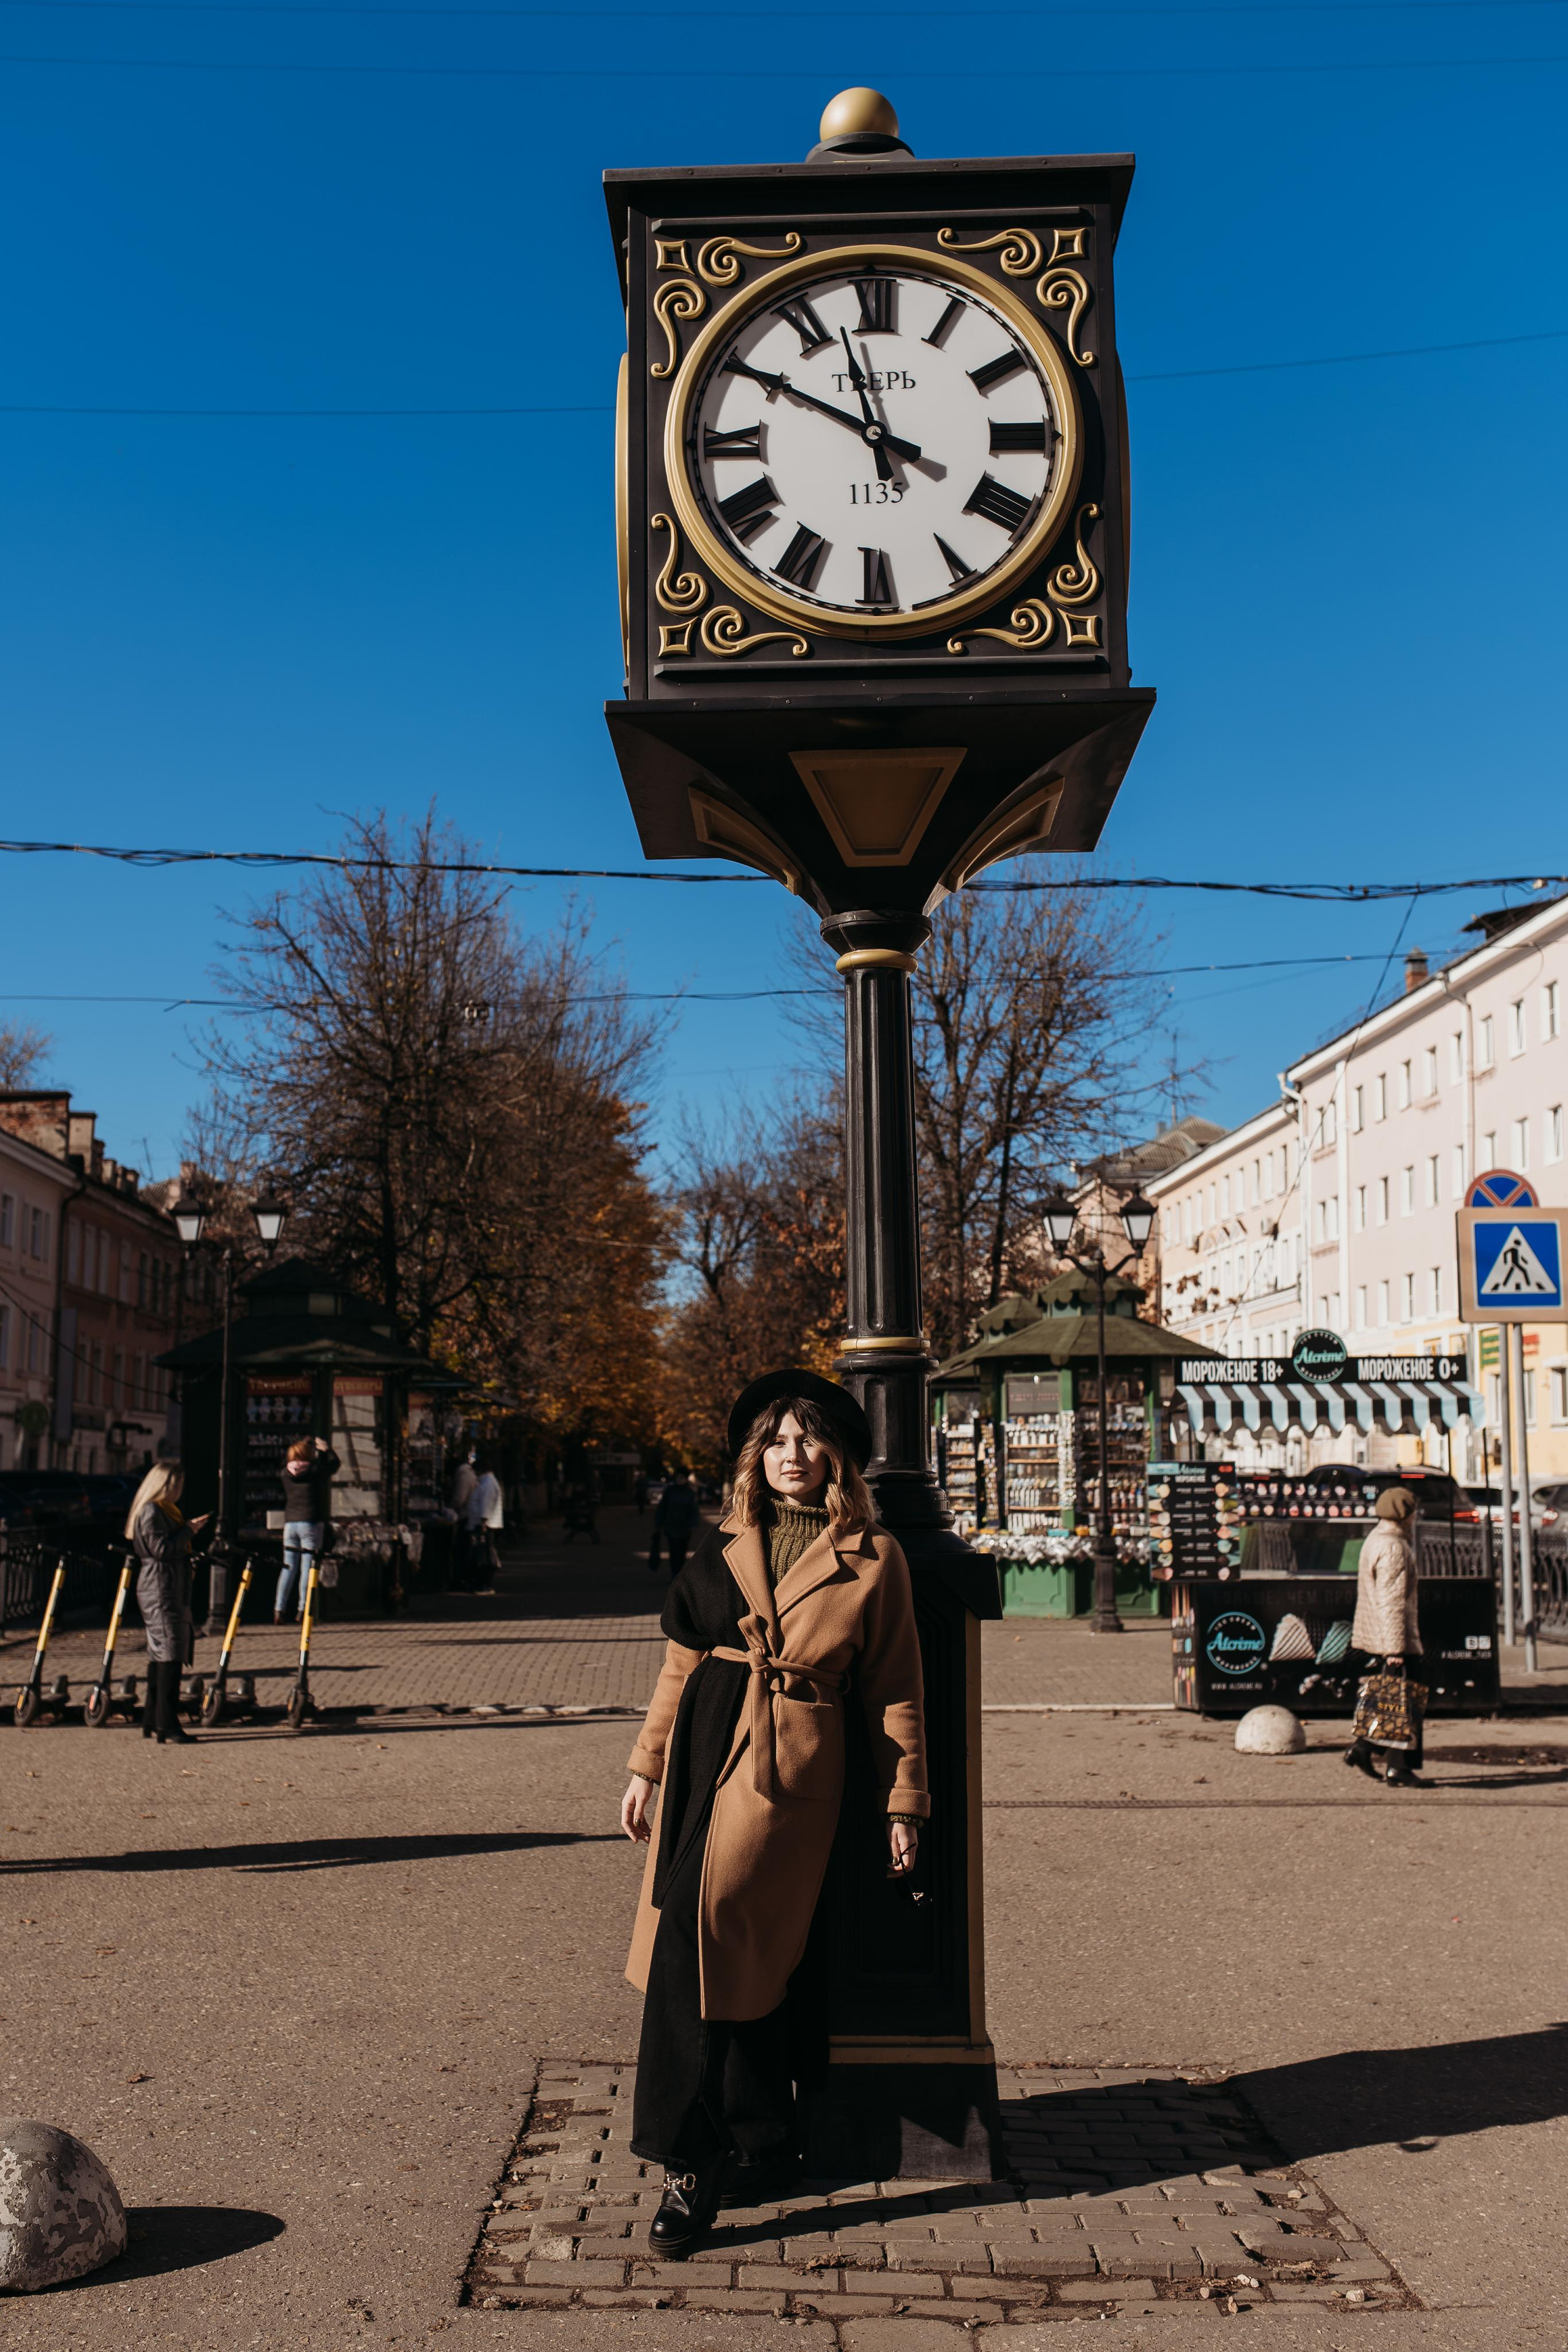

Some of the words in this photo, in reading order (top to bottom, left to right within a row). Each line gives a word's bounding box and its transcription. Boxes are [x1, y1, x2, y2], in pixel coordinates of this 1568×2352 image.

[848, 278, 897, 333] XII
[921, 292, 967, 348] I
[831, 370, 916, 393] ТЕРЬ
[965, 343, 1030, 395] II
[987, 414, 1046, 456] III
[848, 481, 905, 505] 1135
[932, 532, 978, 587] V
[1182, 1360, 1258, 1382] МОРОЖЕНОЕ
[1261, 1360, 1284, 1382] 18+
[1357, 1357, 1434, 1381] МОРОЖЕНОЕ
[1439, 1357, 1460, 1380] 0+
[1377, 1702, 1407, 1714] STYLE
